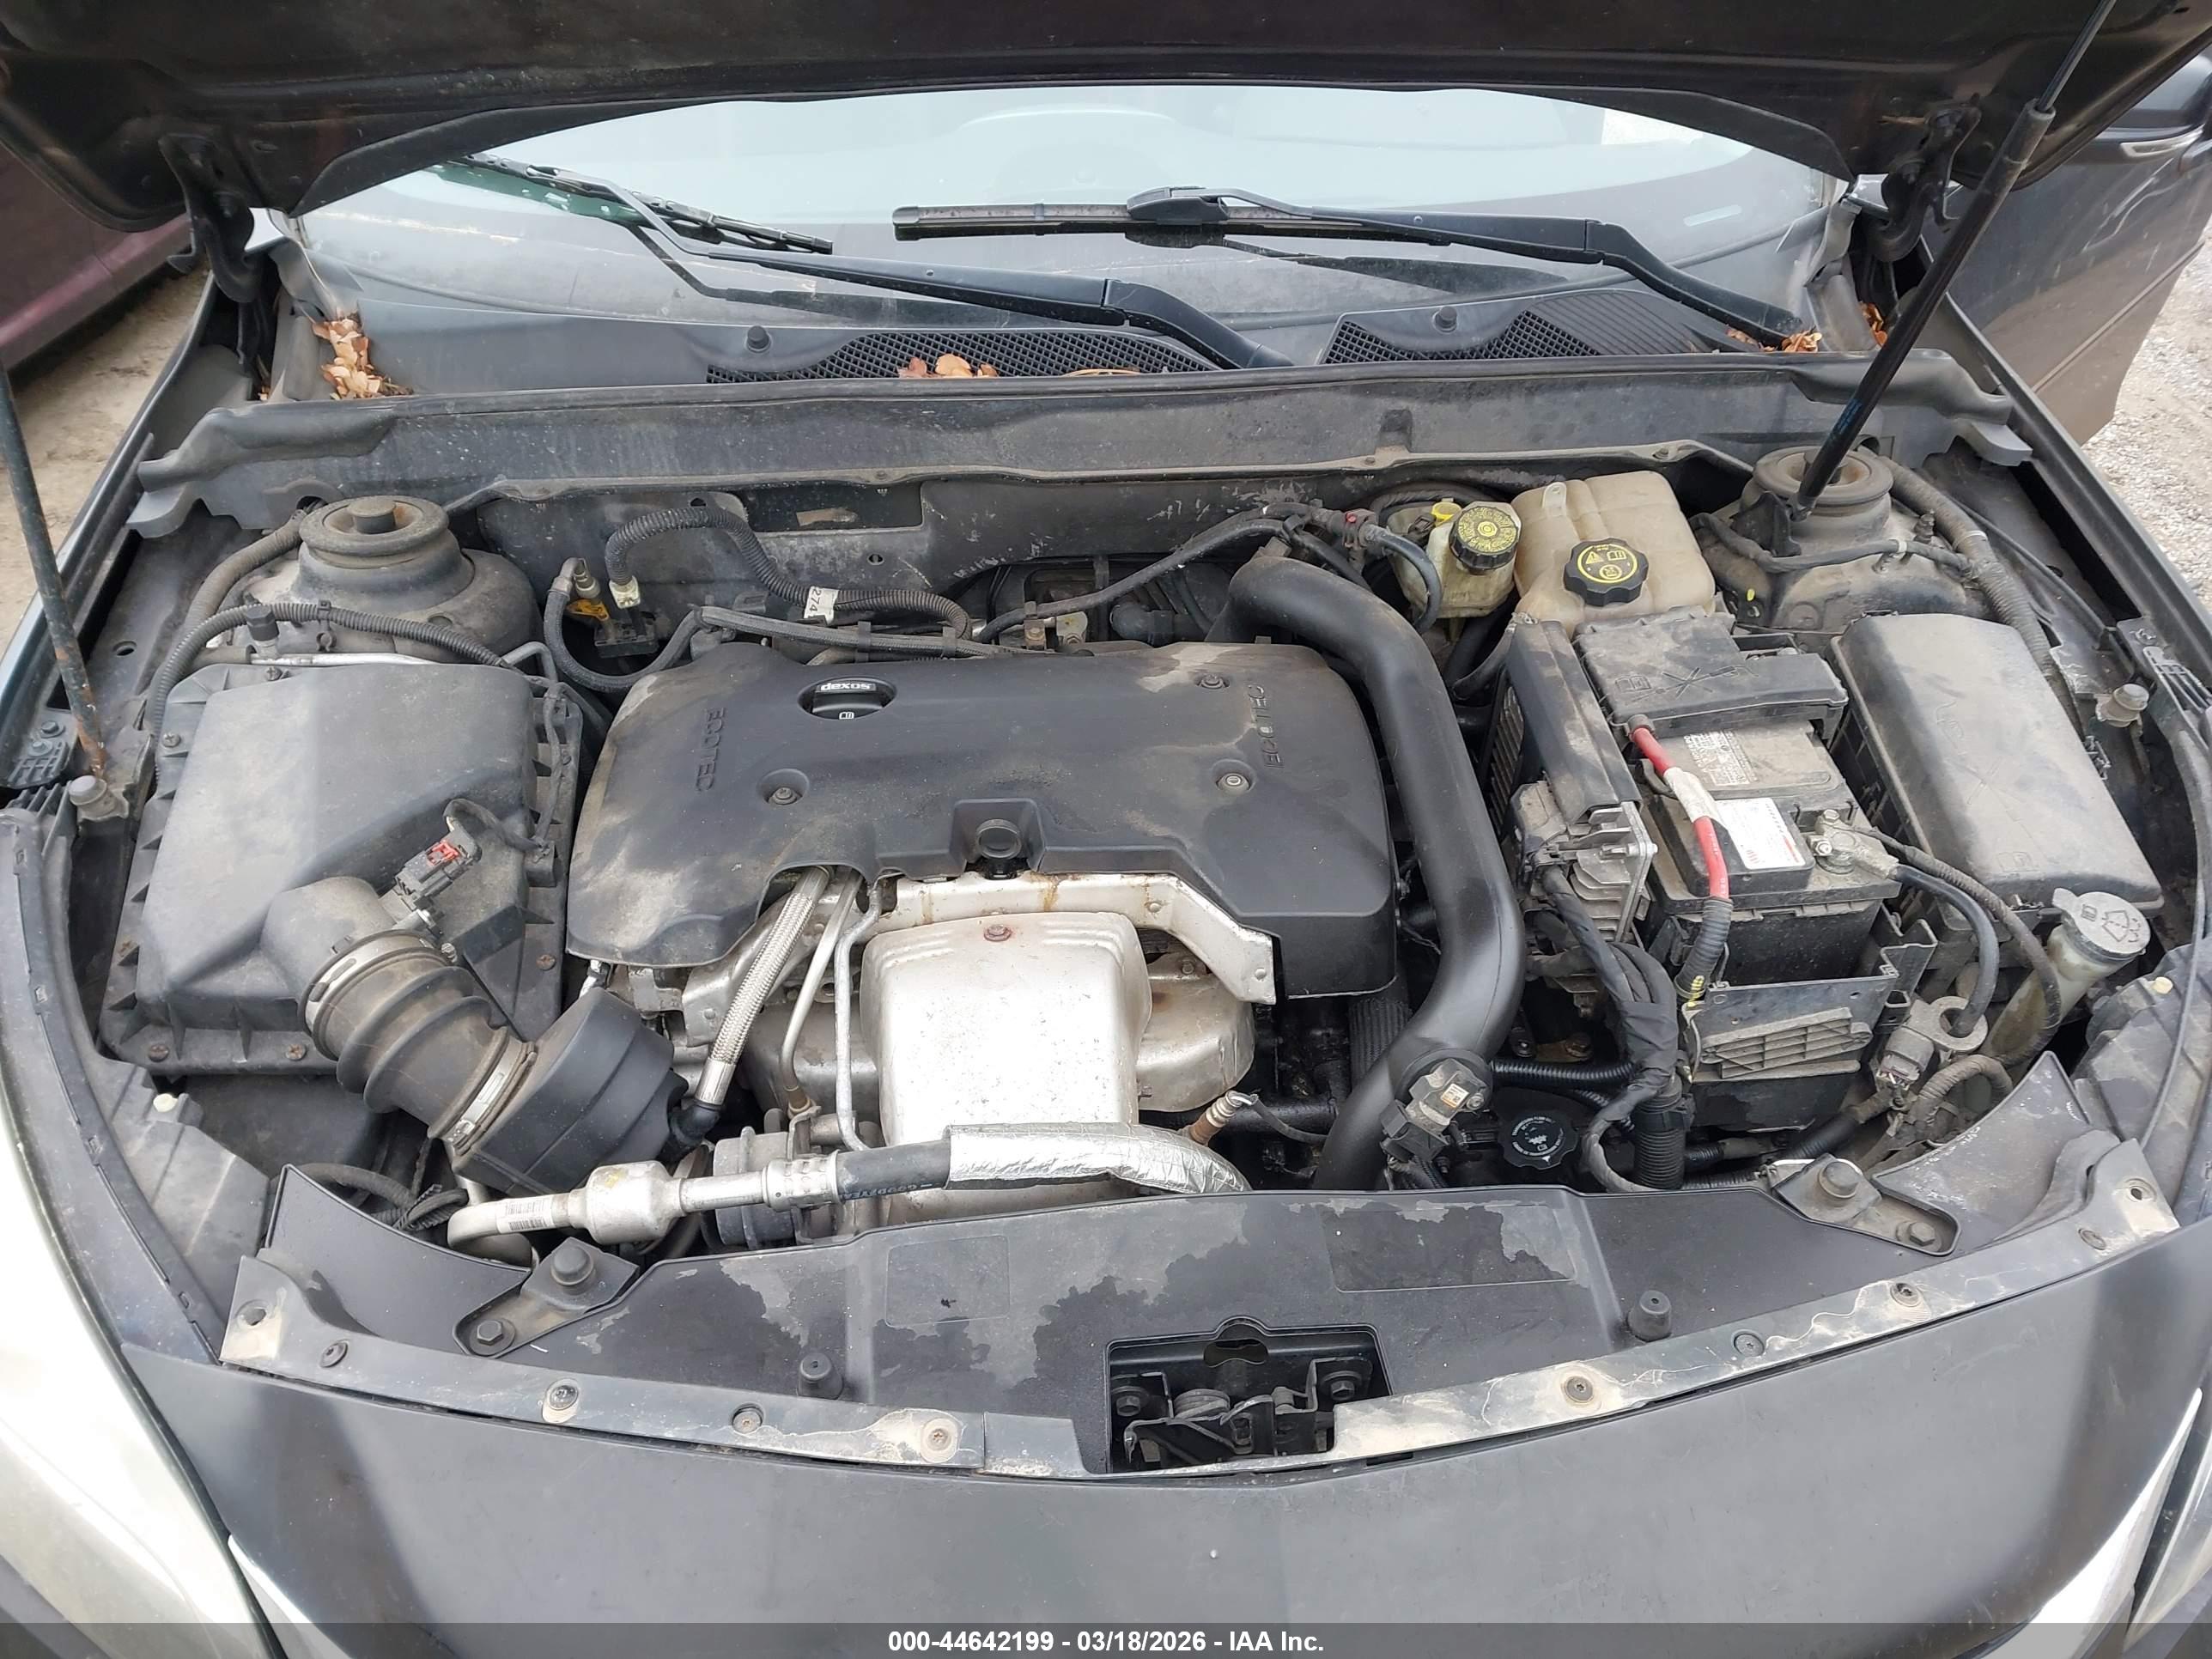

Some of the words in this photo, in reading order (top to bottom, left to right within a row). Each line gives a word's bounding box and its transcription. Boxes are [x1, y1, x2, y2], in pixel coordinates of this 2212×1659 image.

[820, 682, 871, 691] dexos
[1247, 684, 1285, 769] ECOTEC
[696, 707, 727, 792] ECOTEC
